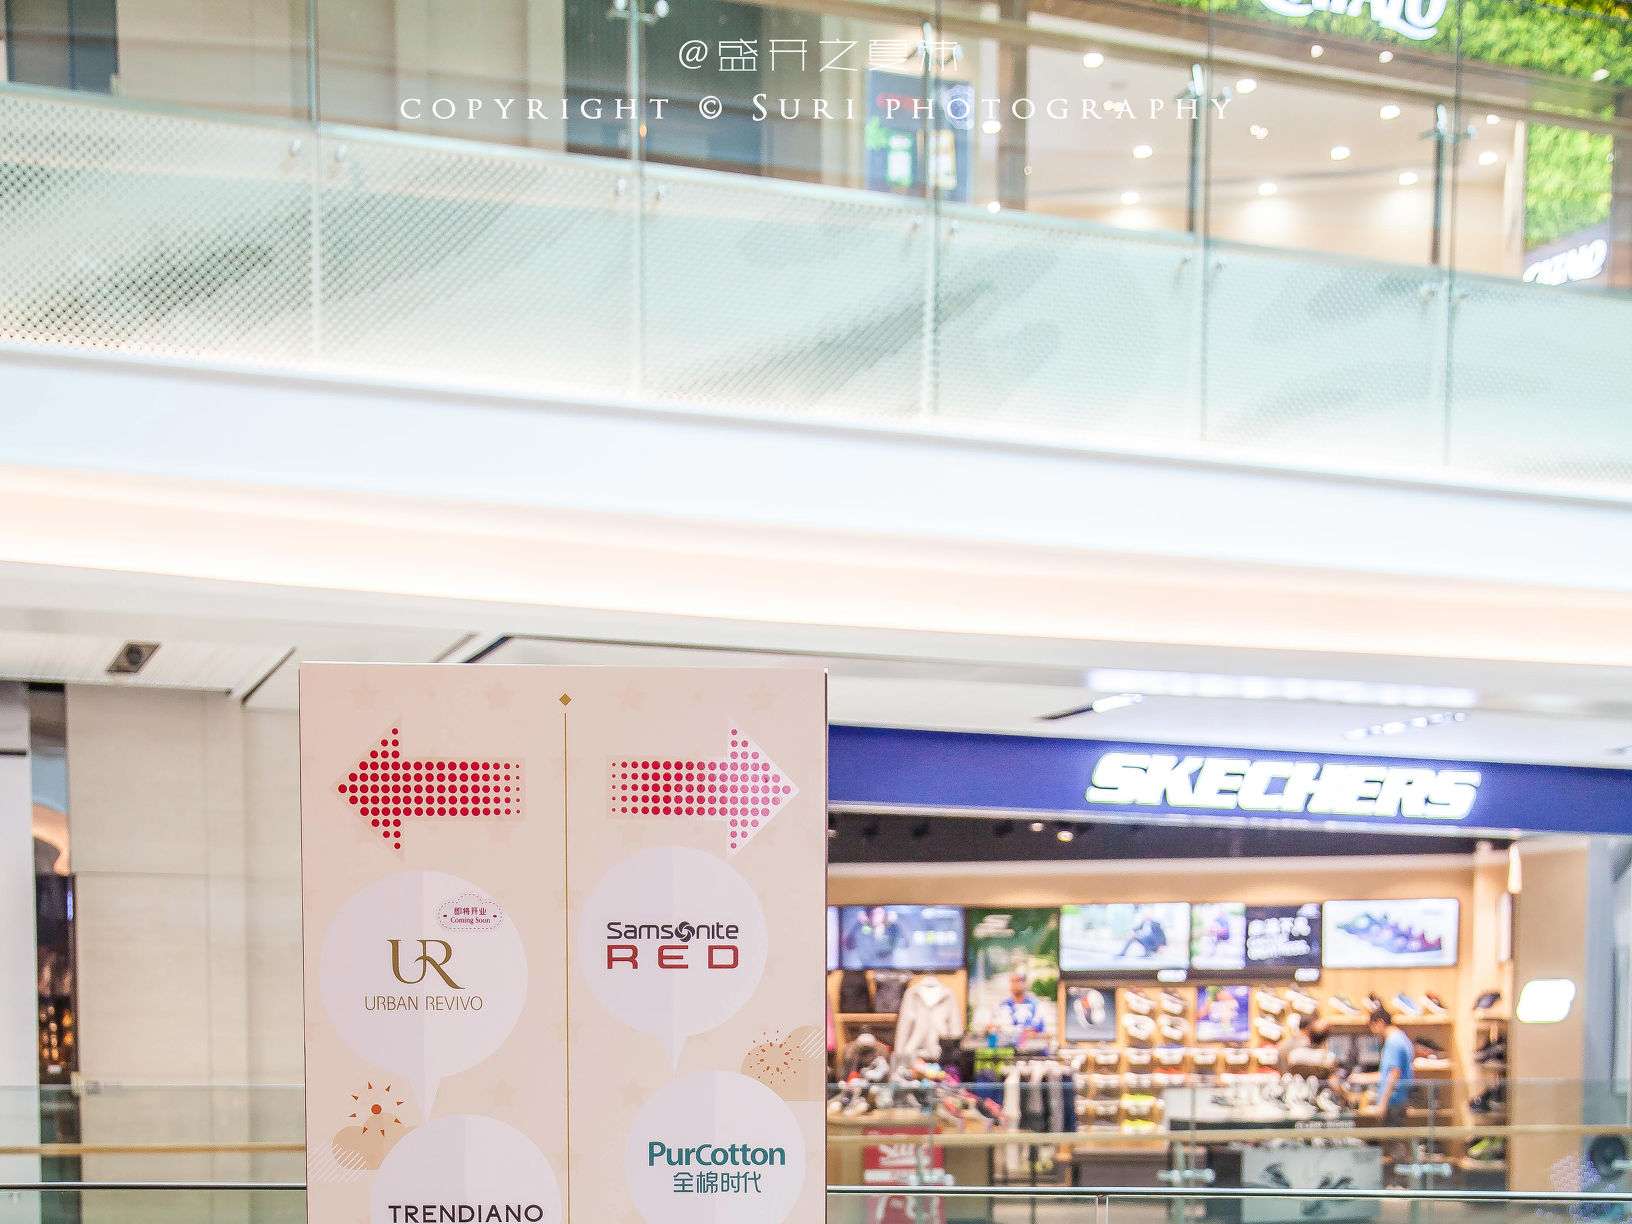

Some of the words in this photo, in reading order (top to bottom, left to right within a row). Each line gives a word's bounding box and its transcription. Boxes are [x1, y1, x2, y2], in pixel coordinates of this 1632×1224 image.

[1086, 752, 1482, 819] SKECHERS
[450, 916, 473, 925] Coming
[475, 916, 491, 924] Soon
[454, 907, 486, 915] 即将开业
[607, 922, 738, 942] Samsonite
[607, 945, 738, 969] RED
[365, 996, 418, 1010] URBAN
[426, 996, 482, 1010] REVIVO
[649, 1142, 785, 1166] PurCotton
[673, 1171, 761, 1193] 全棉时代
[389, 1205, 543, 1223] TRENDIANO
